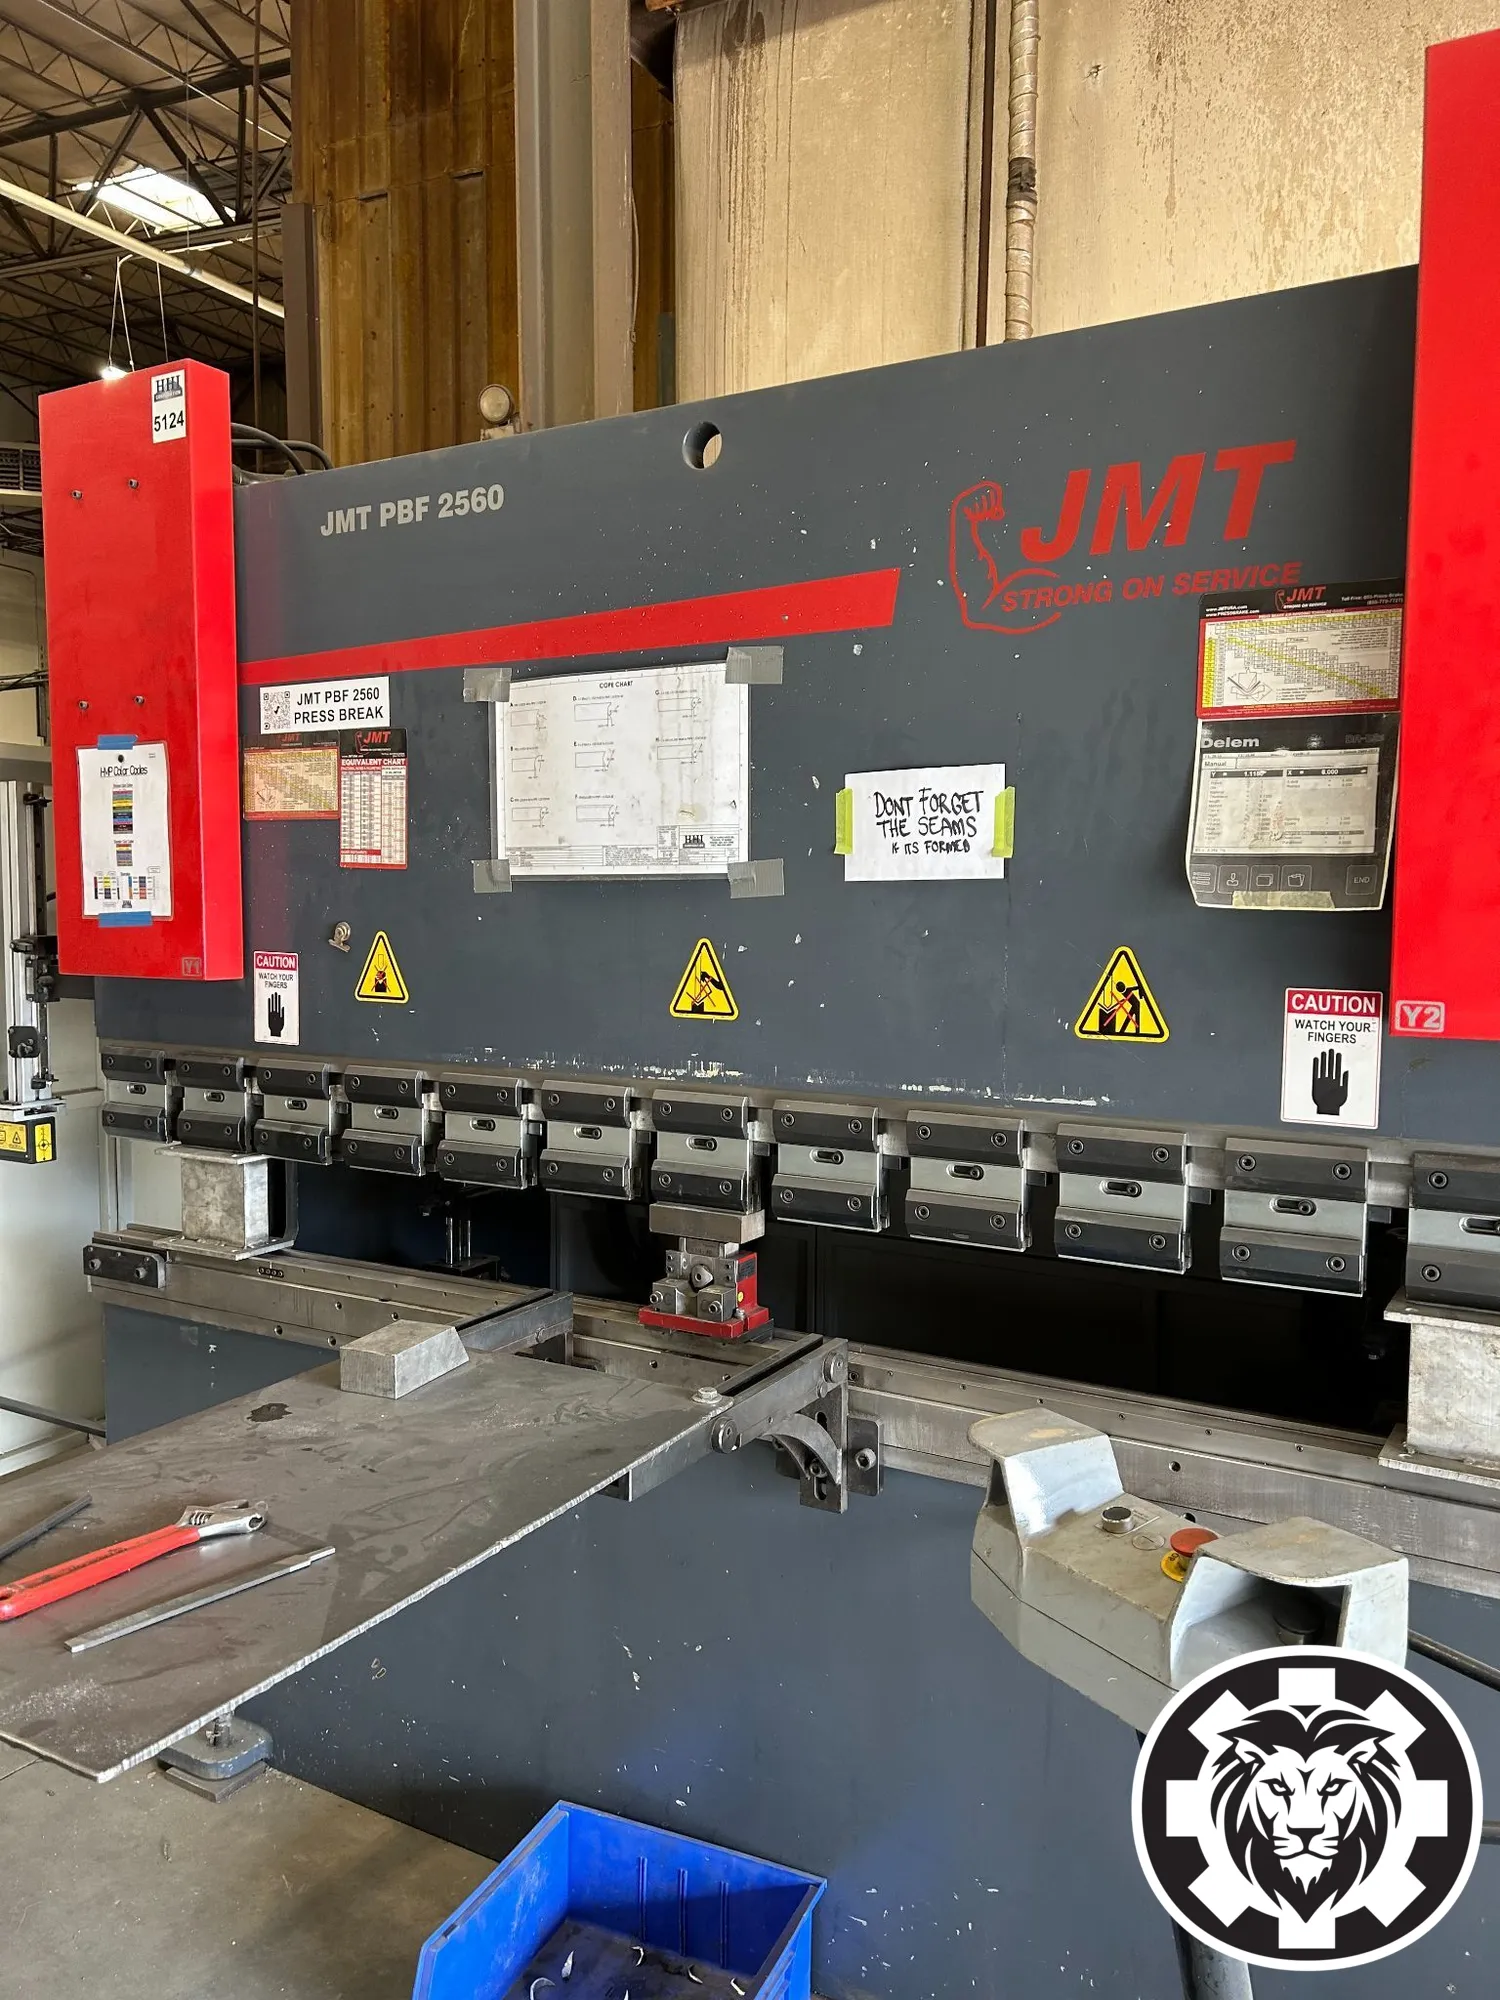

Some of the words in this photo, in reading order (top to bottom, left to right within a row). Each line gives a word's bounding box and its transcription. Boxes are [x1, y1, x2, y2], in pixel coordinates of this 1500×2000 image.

[156, 375, 180, 393] HHI
[154, 410, 184, 432] 5124
[1020, 439, 1296, 562] JMT
[320, 505, 372, 537] JMT
[380, 495, 430, 528] PBF
[438, 483, 505, 519] 2560
[1001, 581, 1113, 612] STRONG
[1122, 575, 1165, 600] ON
[1172, 562, 1303, 595] SERVICE
[1286, 586, 1326, 602] JMT
[615, 680, 633, 688] CHART
[297, 692, 321, 706] JMT
[325, 689, 349, 703] PBF
[353, 687, 380, 701] 2560
[294, 709, 335, 724] PRESS
[339, 706, 384, 721] BREAK
[363, 731, 391, 744] JMT
[1200, 737, 1260, 748] Delem
[130, 764, 149, 776] Codes
[341, 758, 382, 766] EQUIVALENT
[873, 791, 914, 818] DONT
[918, 787, 984, 816] FORGET
[876, 818, 911, 839] THE
[918, 815, 977, 838] SEAMS
[685, 834, 703, 844] HHI
[904, 842, 920, 855] ITS
[924, 839, 971, 855] FORMED
[1353, 876, 1370, 884] END
[256, 955, 296, 969] CAUTION
[258, 972, 278, 980] WATCH
[279, 973, 294, 981] YOUR
[264, 981, 288, 989] FINGERS
[1291, 993, 1375, 1014] CAUTION
[1402, 1005, 1440, 1029] Y2
[1294, 1019, 1335, 1031] WATCH
[1338, 1021, 1371, 1033] YOUR
[1307, 1031, 1357, 1044] FINGERS
